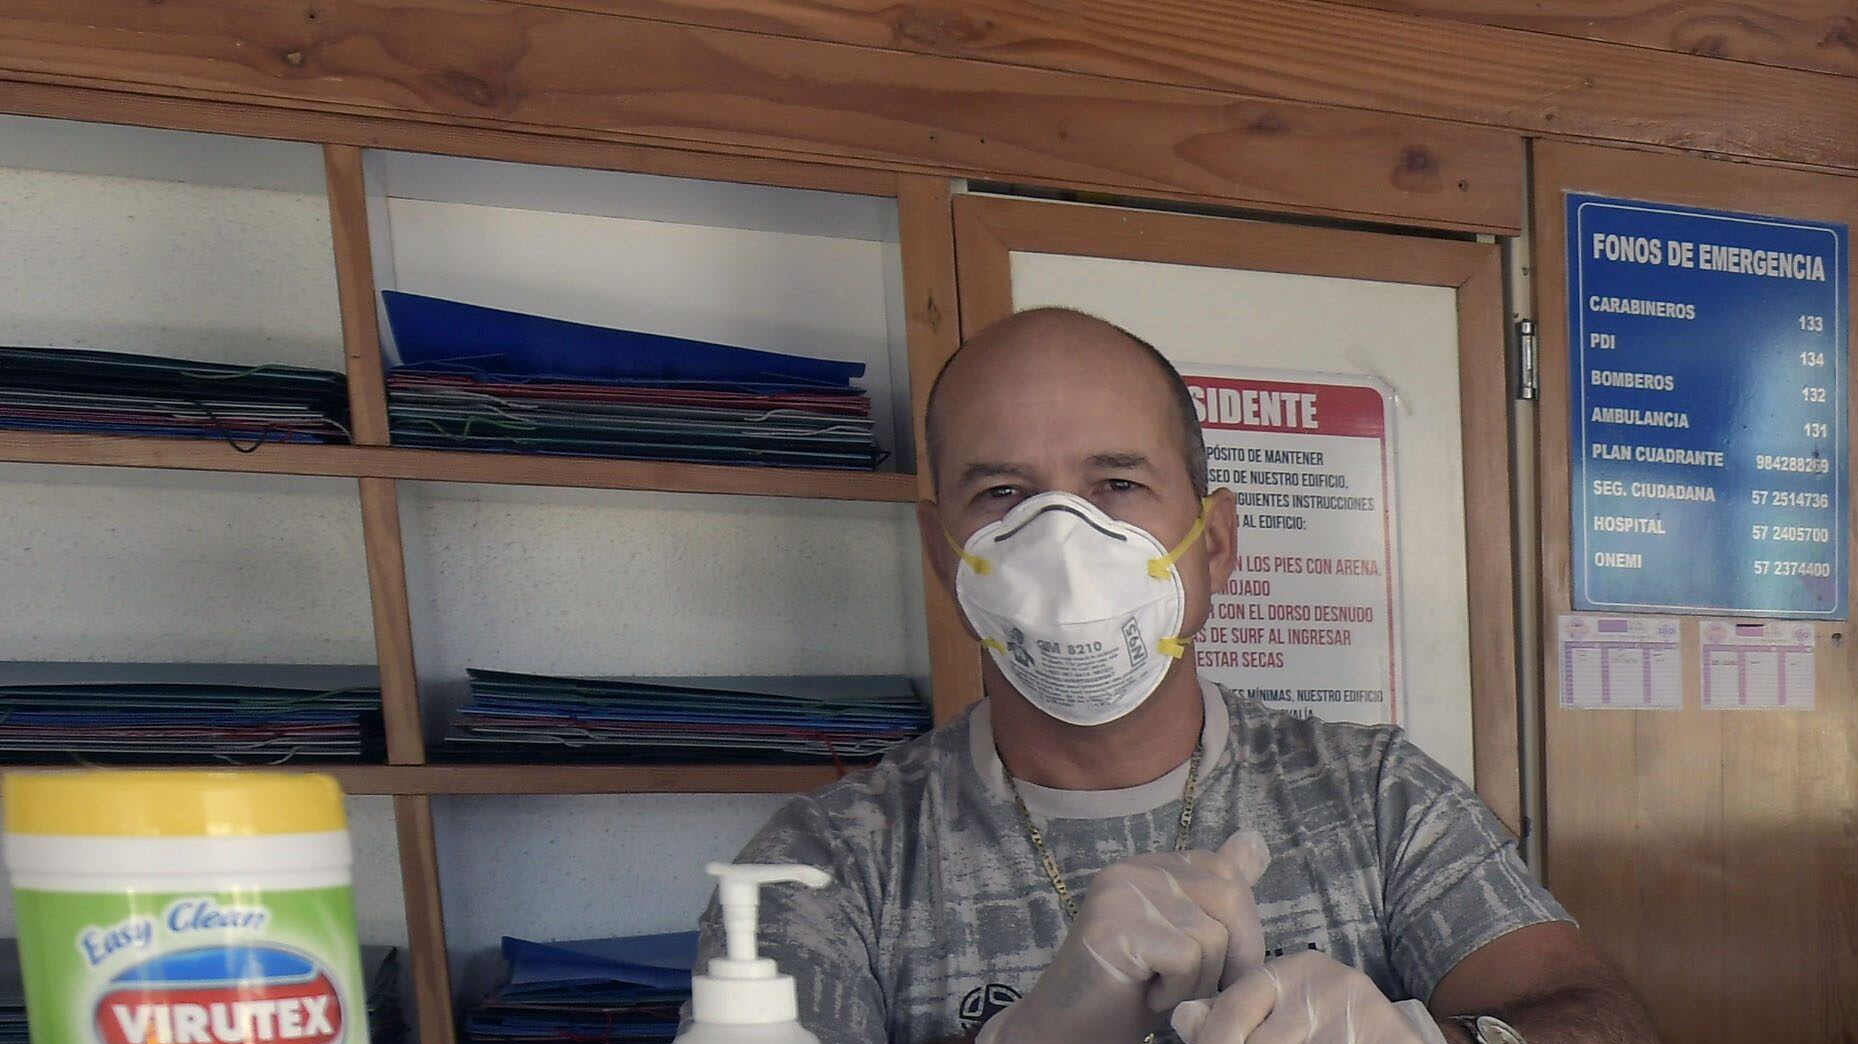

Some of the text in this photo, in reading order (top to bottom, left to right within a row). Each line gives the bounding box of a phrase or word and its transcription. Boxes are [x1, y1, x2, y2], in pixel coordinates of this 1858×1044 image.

[1593, 233, 1826, 282] FONOS DE EMERGENCIA
[1589, 296, 1824, 333] CARABINEROS 133
[1590, 333, 1825, 369] PDI 134
[1591, 370, 1826, 405] BOMBEROS 132
[1591, 407, 1827, 440] AMBULANCIA 131
[1248, 449, 1261, 463] DE
[1265, 450, 1324, 466] MANTENER
[1592, 444, 1631, 464] PLAN
[1635, 446, 1724, 469] CUADRANTE
[1233, 470, 1246, 484] DE
[1250, 471, 1299, 486] NUESTRO
[1292, 494, 1375, 511] INSTRUCCIONES
[1593, 480, 1829, 509] SEG. CIUDADANA 57 2514736
[1242, 515, 1306, 531] AL EDIFICIO:
[1593, 516, 1829, 544] HOSPITAL 57 2405700
[1246, 556, 1271, 572] LOS
[1275, 557, 1302, 574] PIES
[1306, 558, 1332, 574] CON
[1594, 552, 1830, 579] ONEMI 57 2374400
[1219, 604, 1245, 620] CON
[1249, 605, 1264, 620] EL
[1268, 605, 1310, 621] DORSO
[1314, 606, 1373, 622] DESNUDO
[1067, 641, 1102, 655] 8210
[1126, 623, 1145, 663] N95
[1211, 627, 1227, 643] DE
[1232, 628, 1264, 644] SURF
[1268, 629, 1284, 645] AL
[1288, 629, 1352, 646] INGRESAR
[1197, 651, 1284, 668] ESTAR SECAS
[1297, 690, 1341, 702] NUESTRO
[1344, 690, 1384, 702] EDIFICIO
[80, 902, 266, 965] Easy Clean
